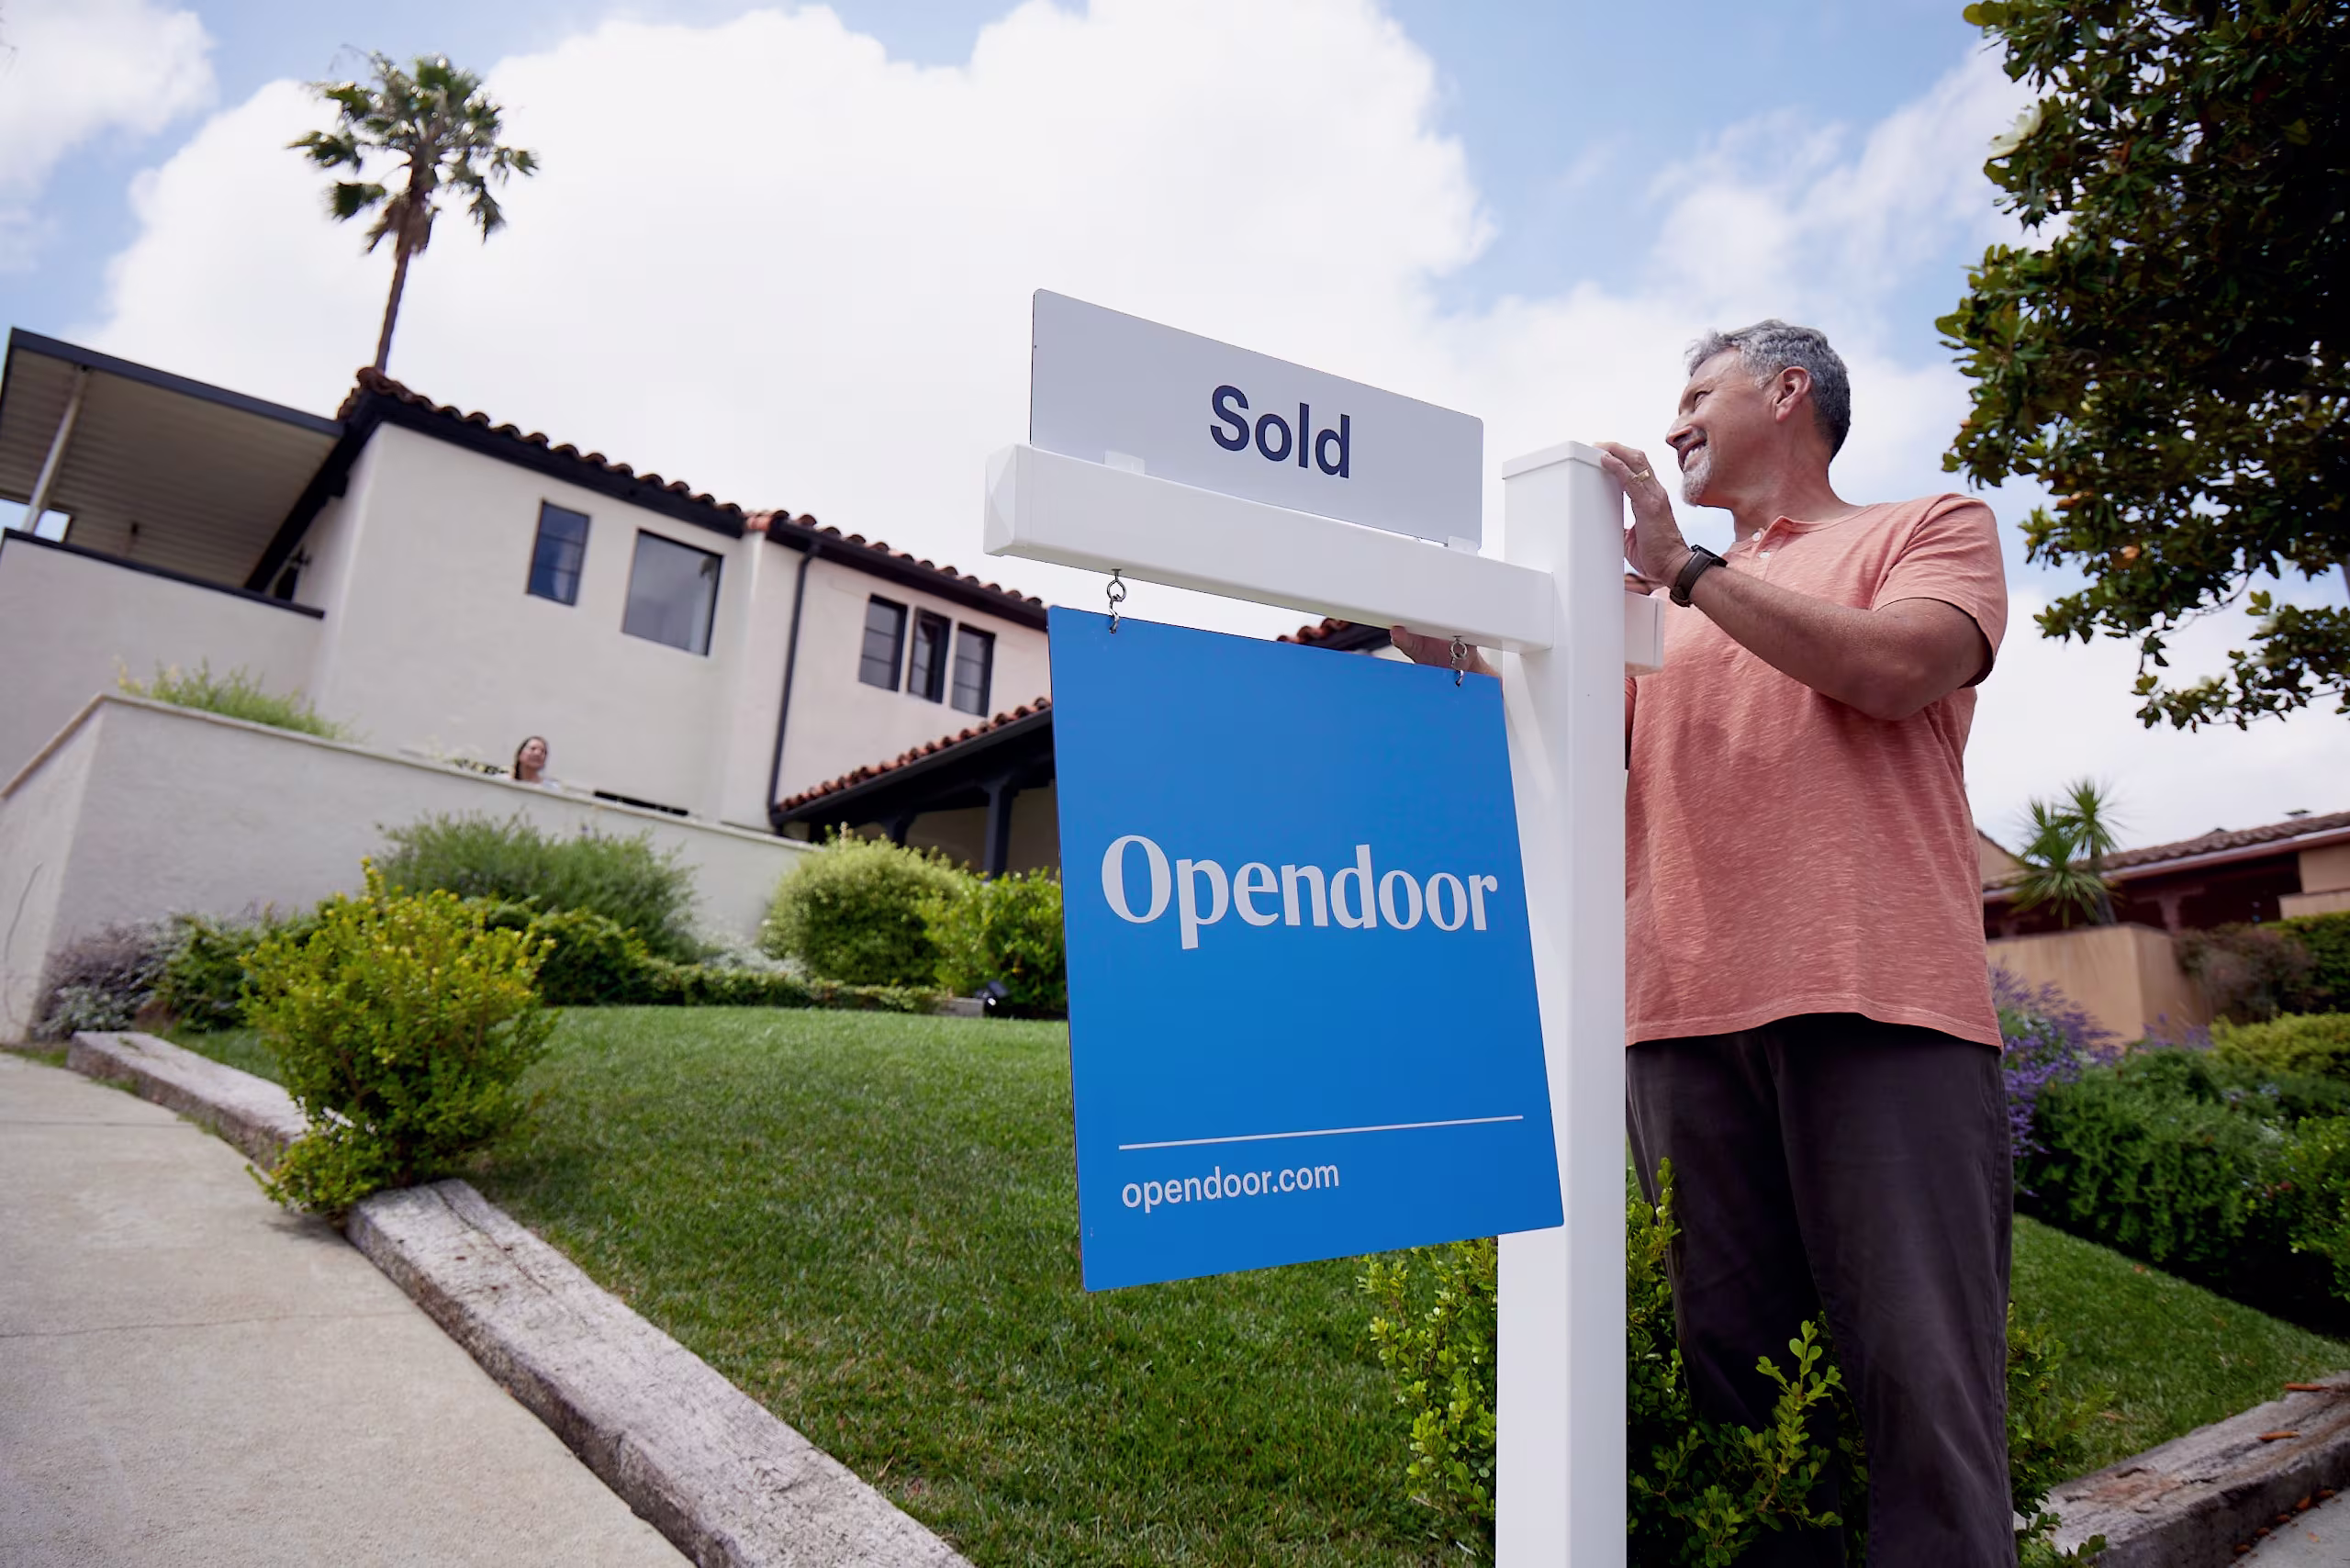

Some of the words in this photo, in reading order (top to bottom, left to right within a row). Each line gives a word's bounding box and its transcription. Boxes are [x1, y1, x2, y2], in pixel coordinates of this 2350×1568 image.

[1210, 385, 1350, 479] Sold
[1101, 834, 1498, 950] Opendoor
[1122, 1164, 1339, 1214] opendoor.com
